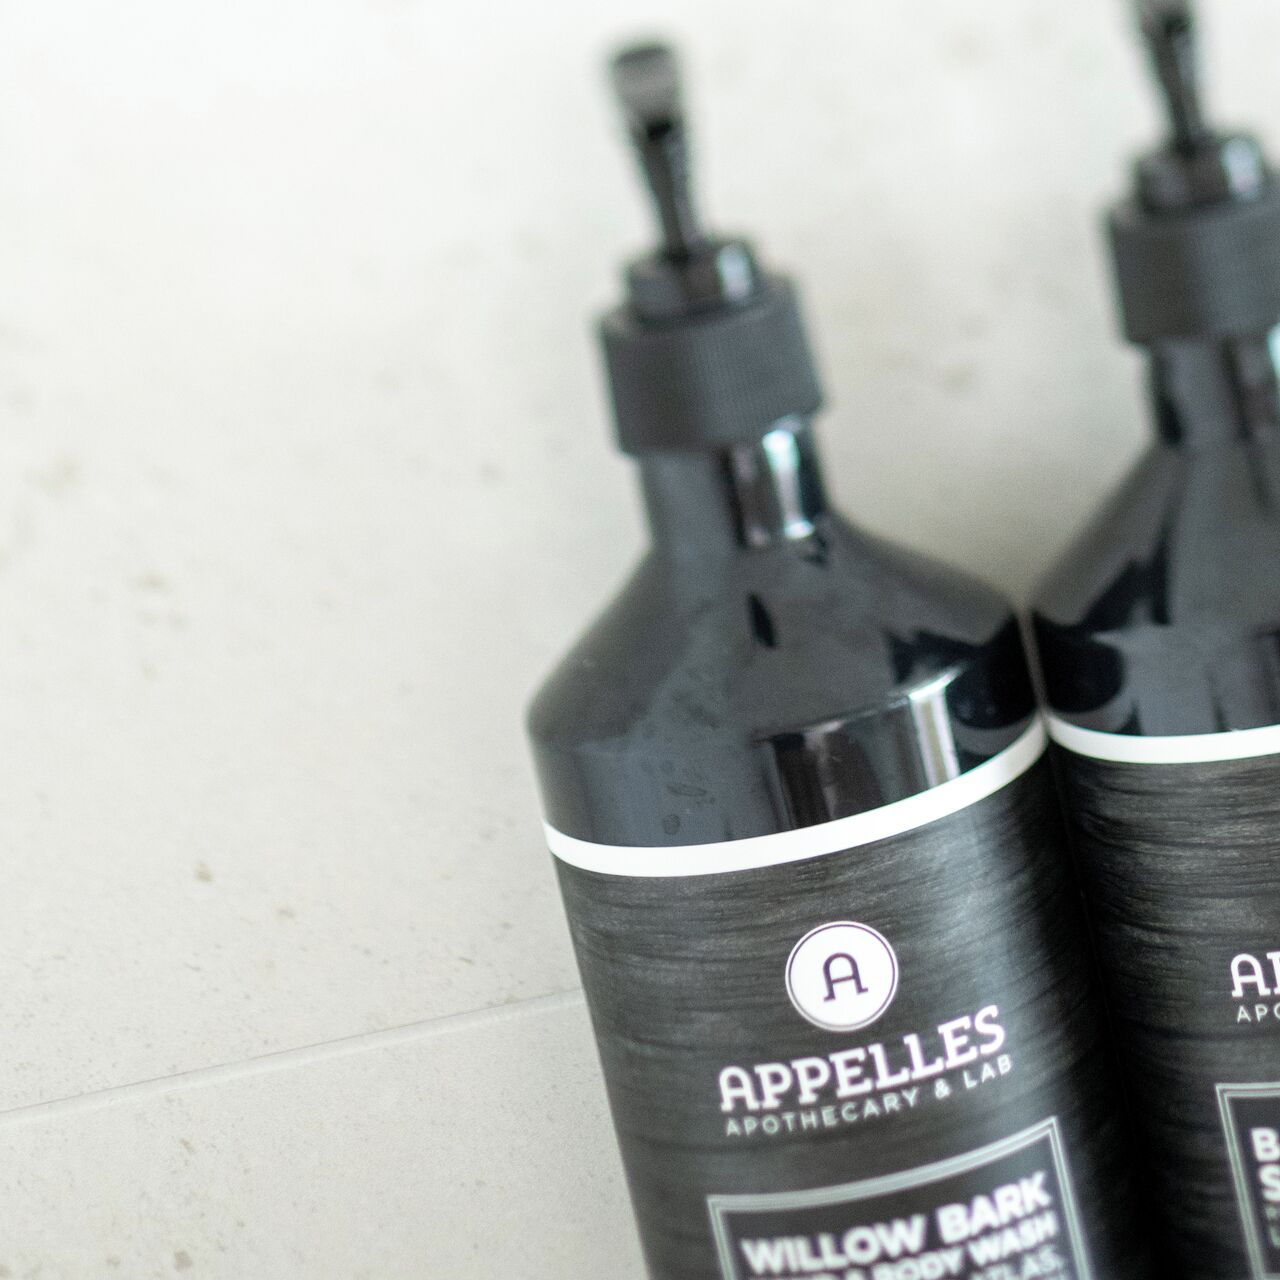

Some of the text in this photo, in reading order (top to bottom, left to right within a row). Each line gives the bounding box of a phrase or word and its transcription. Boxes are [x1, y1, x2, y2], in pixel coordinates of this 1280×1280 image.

[822, 952, 869, 1002] A
[718, 1004, 1006, 1112] APPELLES
[726, 1054, 1013, 1137] APOTHECARY & LAB
[741, 1171, 1052, 1274] WILLOW BARK
[967, 1210, 1058, 1266] WASH
